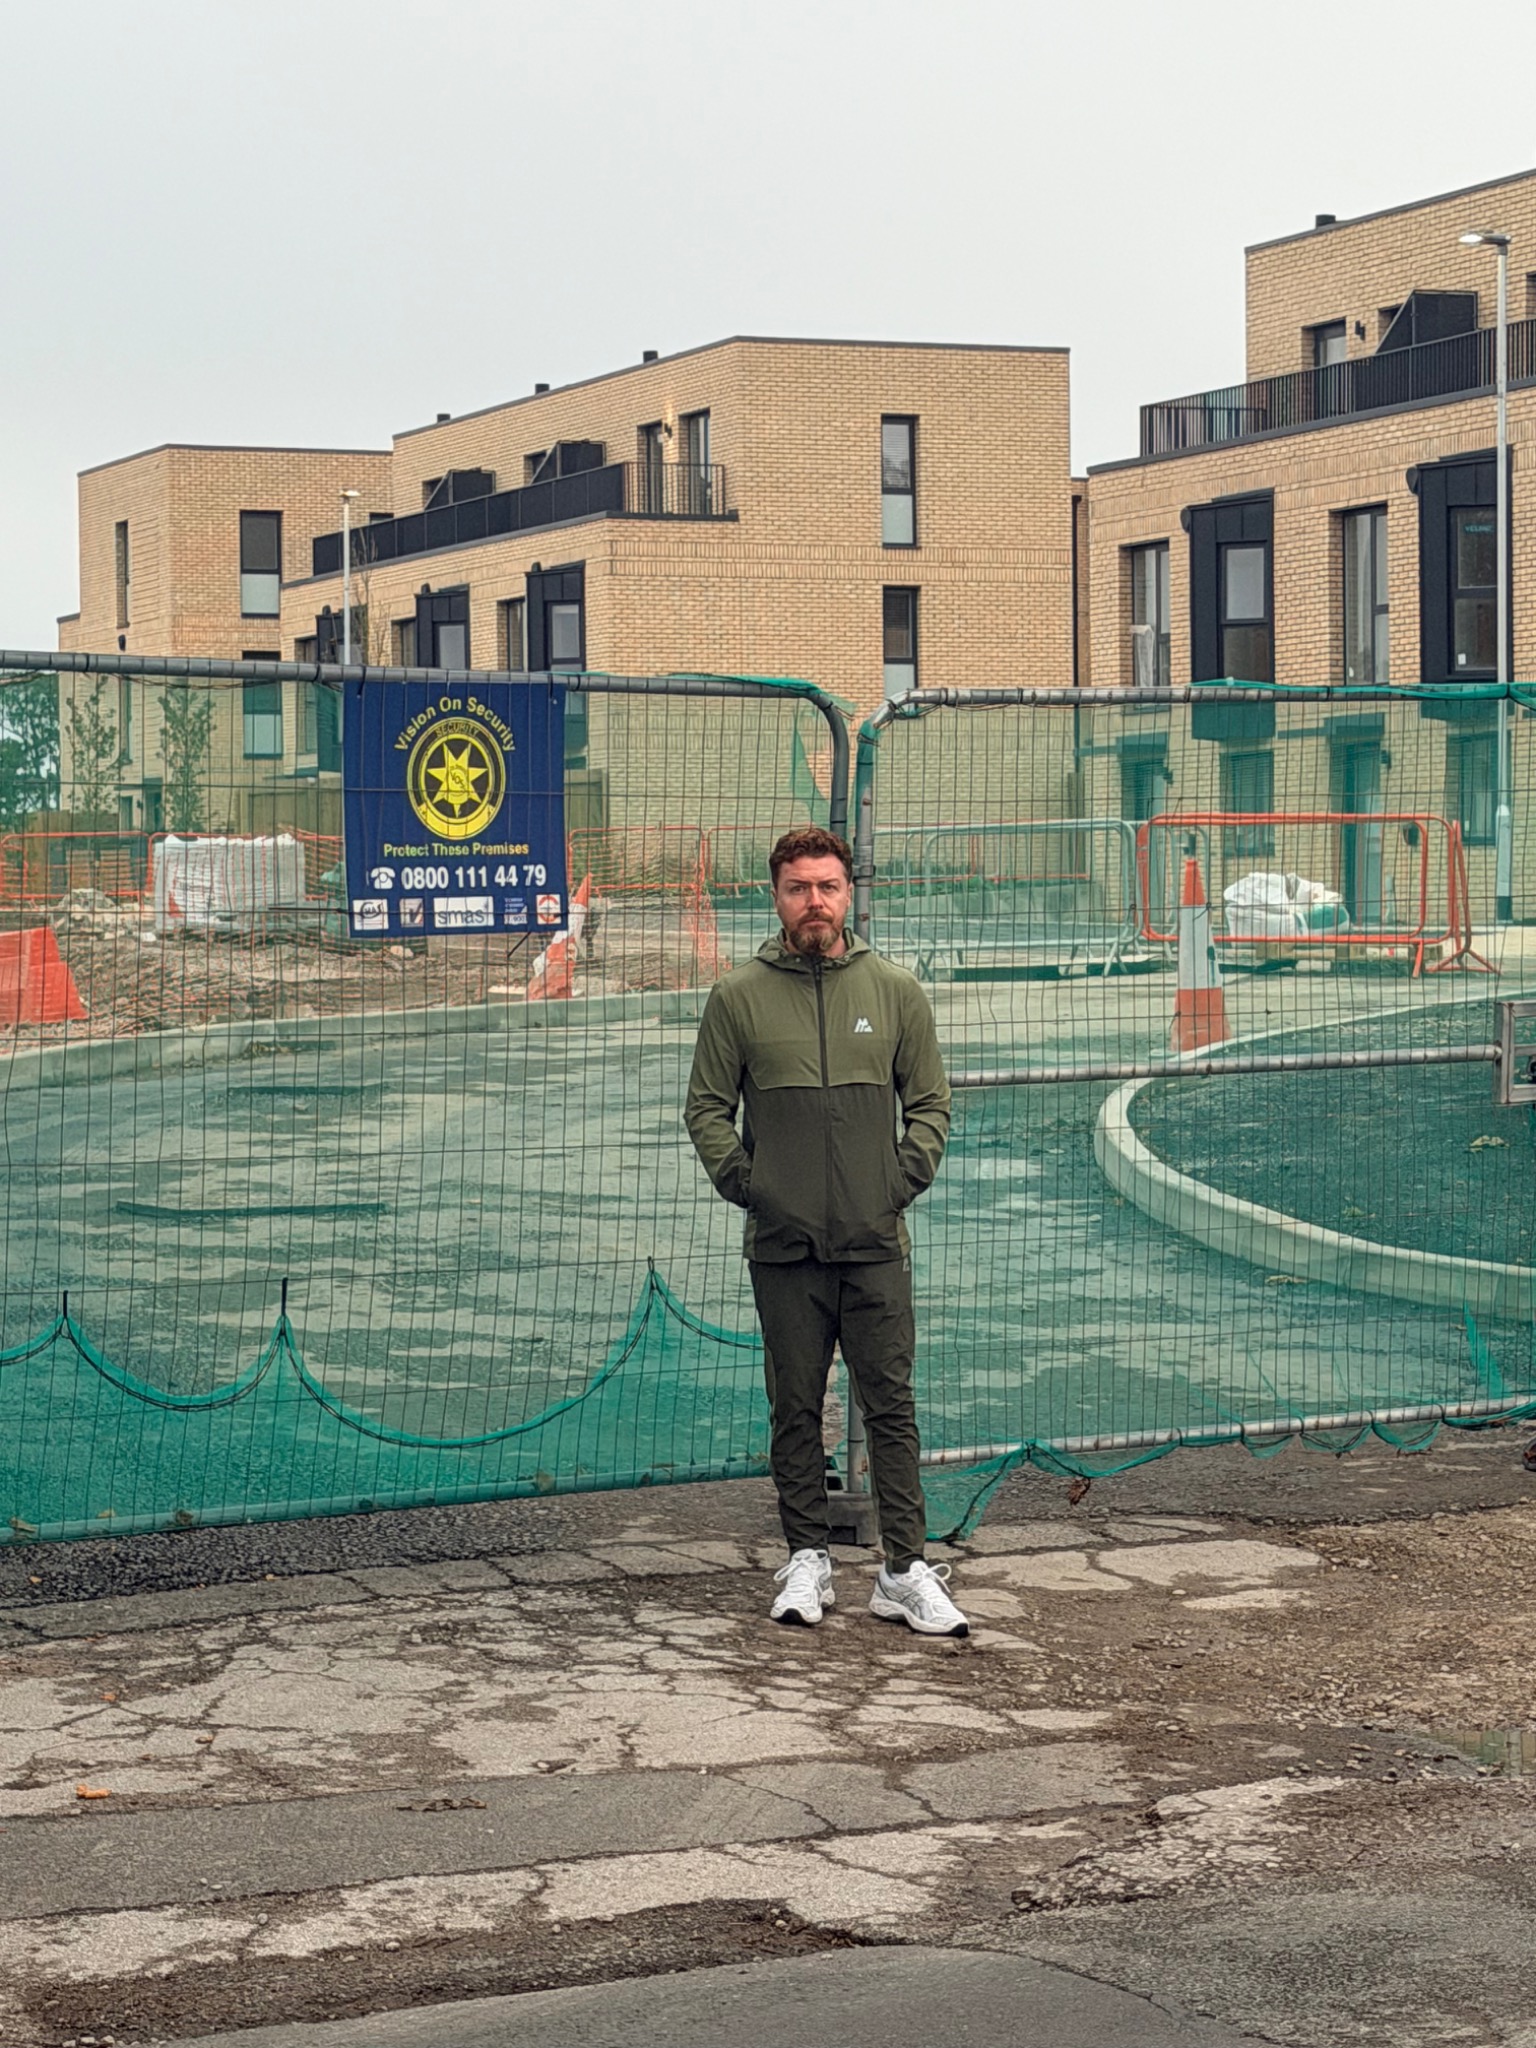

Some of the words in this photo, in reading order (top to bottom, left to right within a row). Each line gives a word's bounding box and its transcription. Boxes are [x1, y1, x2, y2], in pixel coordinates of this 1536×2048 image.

[394, 706, 436, 750] Vision
[440, 697, 461, 712] On
[467, 697, 515, 751] Security
[436, 720, 480, 737] SECURITY
[383, 843, 429, 857] Protect
[432, 843, 469, 856] These
[472, 842, 529, 855] Premises
[401, 866, 449, 890] 0800
[455, 866, 487, 888] 111
[494, 865, 518, 887] 44
[523, 864, 547, 886] 79
[438, 909, 485, 925] smas
